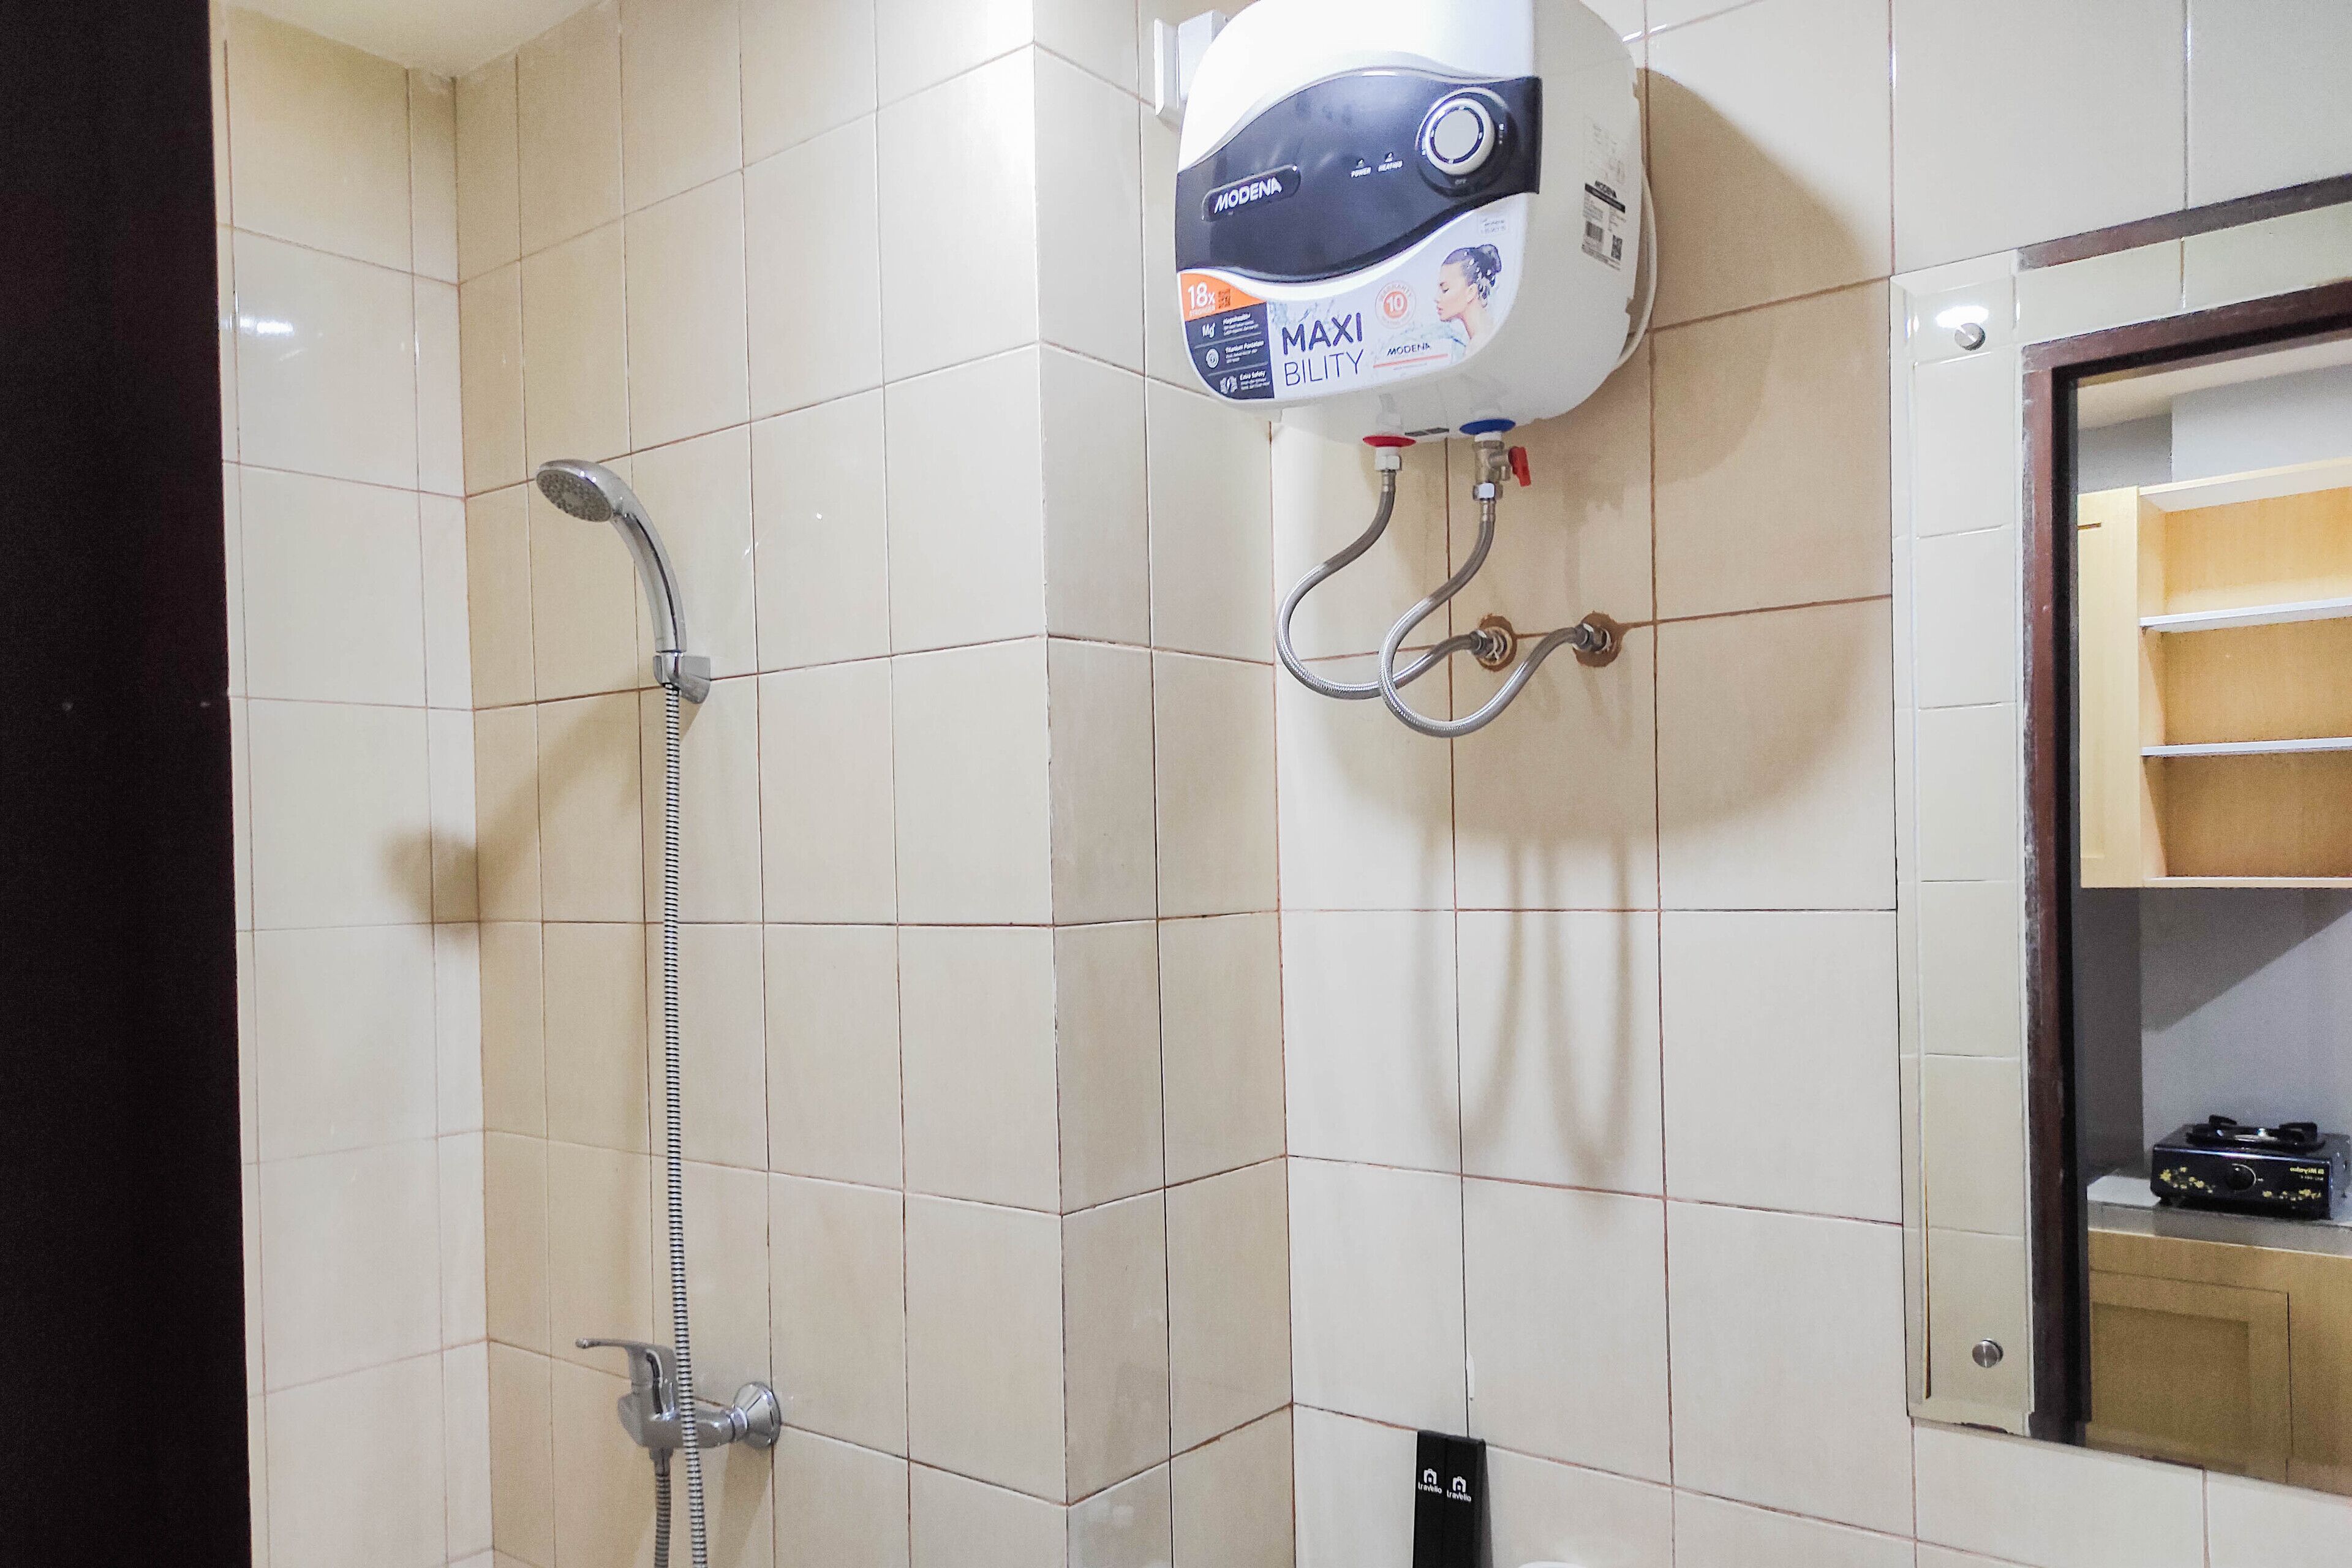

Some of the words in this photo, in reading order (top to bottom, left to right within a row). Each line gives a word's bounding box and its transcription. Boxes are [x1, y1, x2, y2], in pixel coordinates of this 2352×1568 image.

[1214, 176, 1282, 214] MODENA
[1188, 282, 1216, 309] 18x
[1386, 294, 1405, 312] 10
[1281, 312, 1362, 355] MAXI
[1387, 342, 1431, 356] MODENA
[1284, 349, 1364, 386] BILITY
